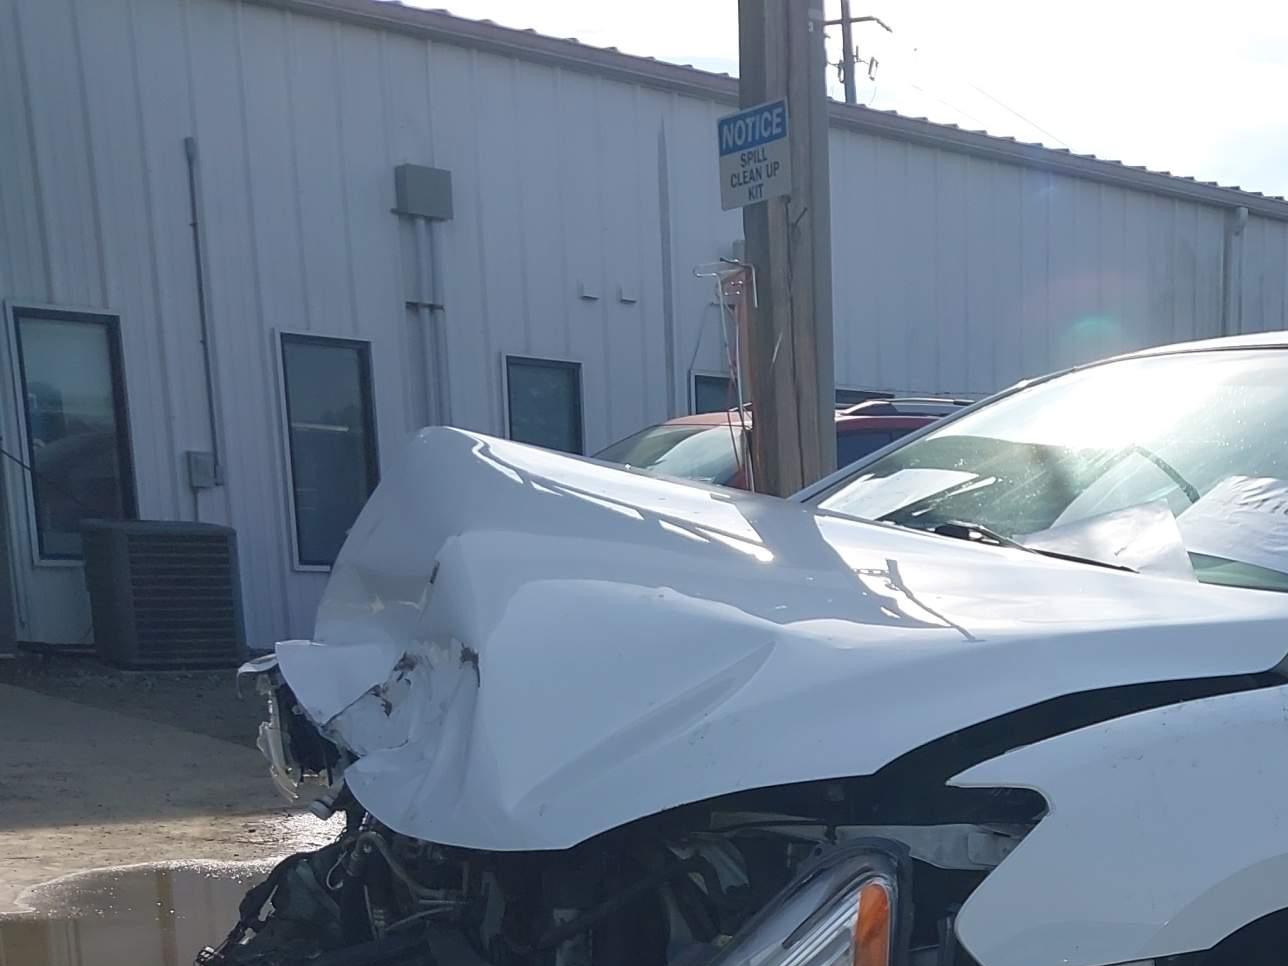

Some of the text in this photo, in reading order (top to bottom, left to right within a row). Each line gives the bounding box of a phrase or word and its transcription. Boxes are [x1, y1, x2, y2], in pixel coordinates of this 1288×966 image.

[722, 107, 784, 151] NOTICE
[740, 147, 767, 168] SPILL
[730, 161, 780, 188] CLEAN UP
[748, 183, 764, 200] KIT
